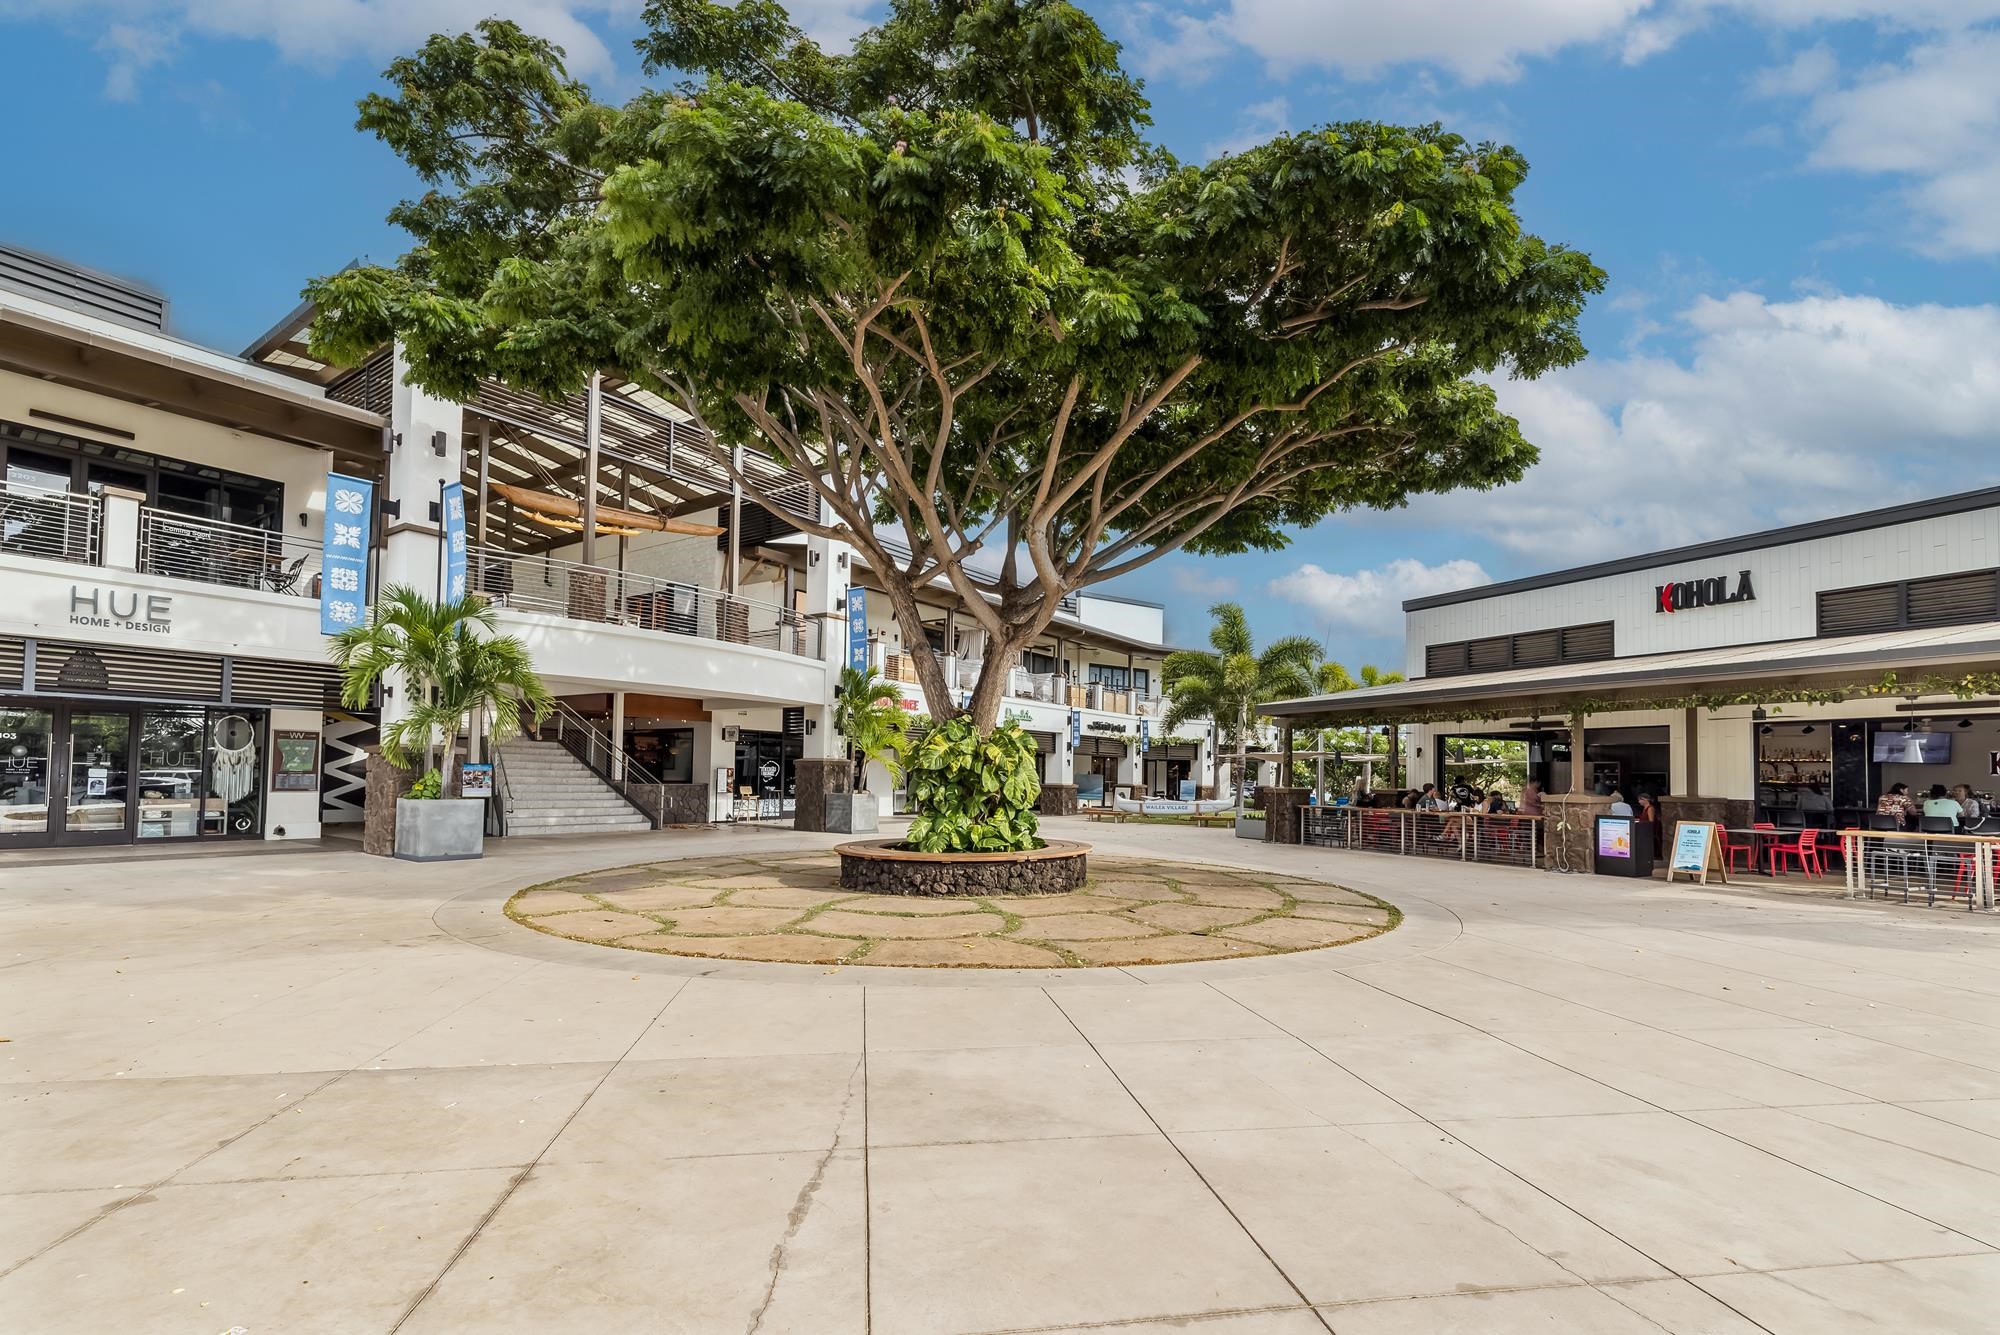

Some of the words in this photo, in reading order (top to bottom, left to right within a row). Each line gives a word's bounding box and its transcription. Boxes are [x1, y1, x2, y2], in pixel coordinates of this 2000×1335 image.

[71, 585, 172, 622] HUE
[1655, 570, 1756, 613] KOHOLĀ
[70, 615, 110, 627] HOME
[125, 621, 170, 633] DESIGN
